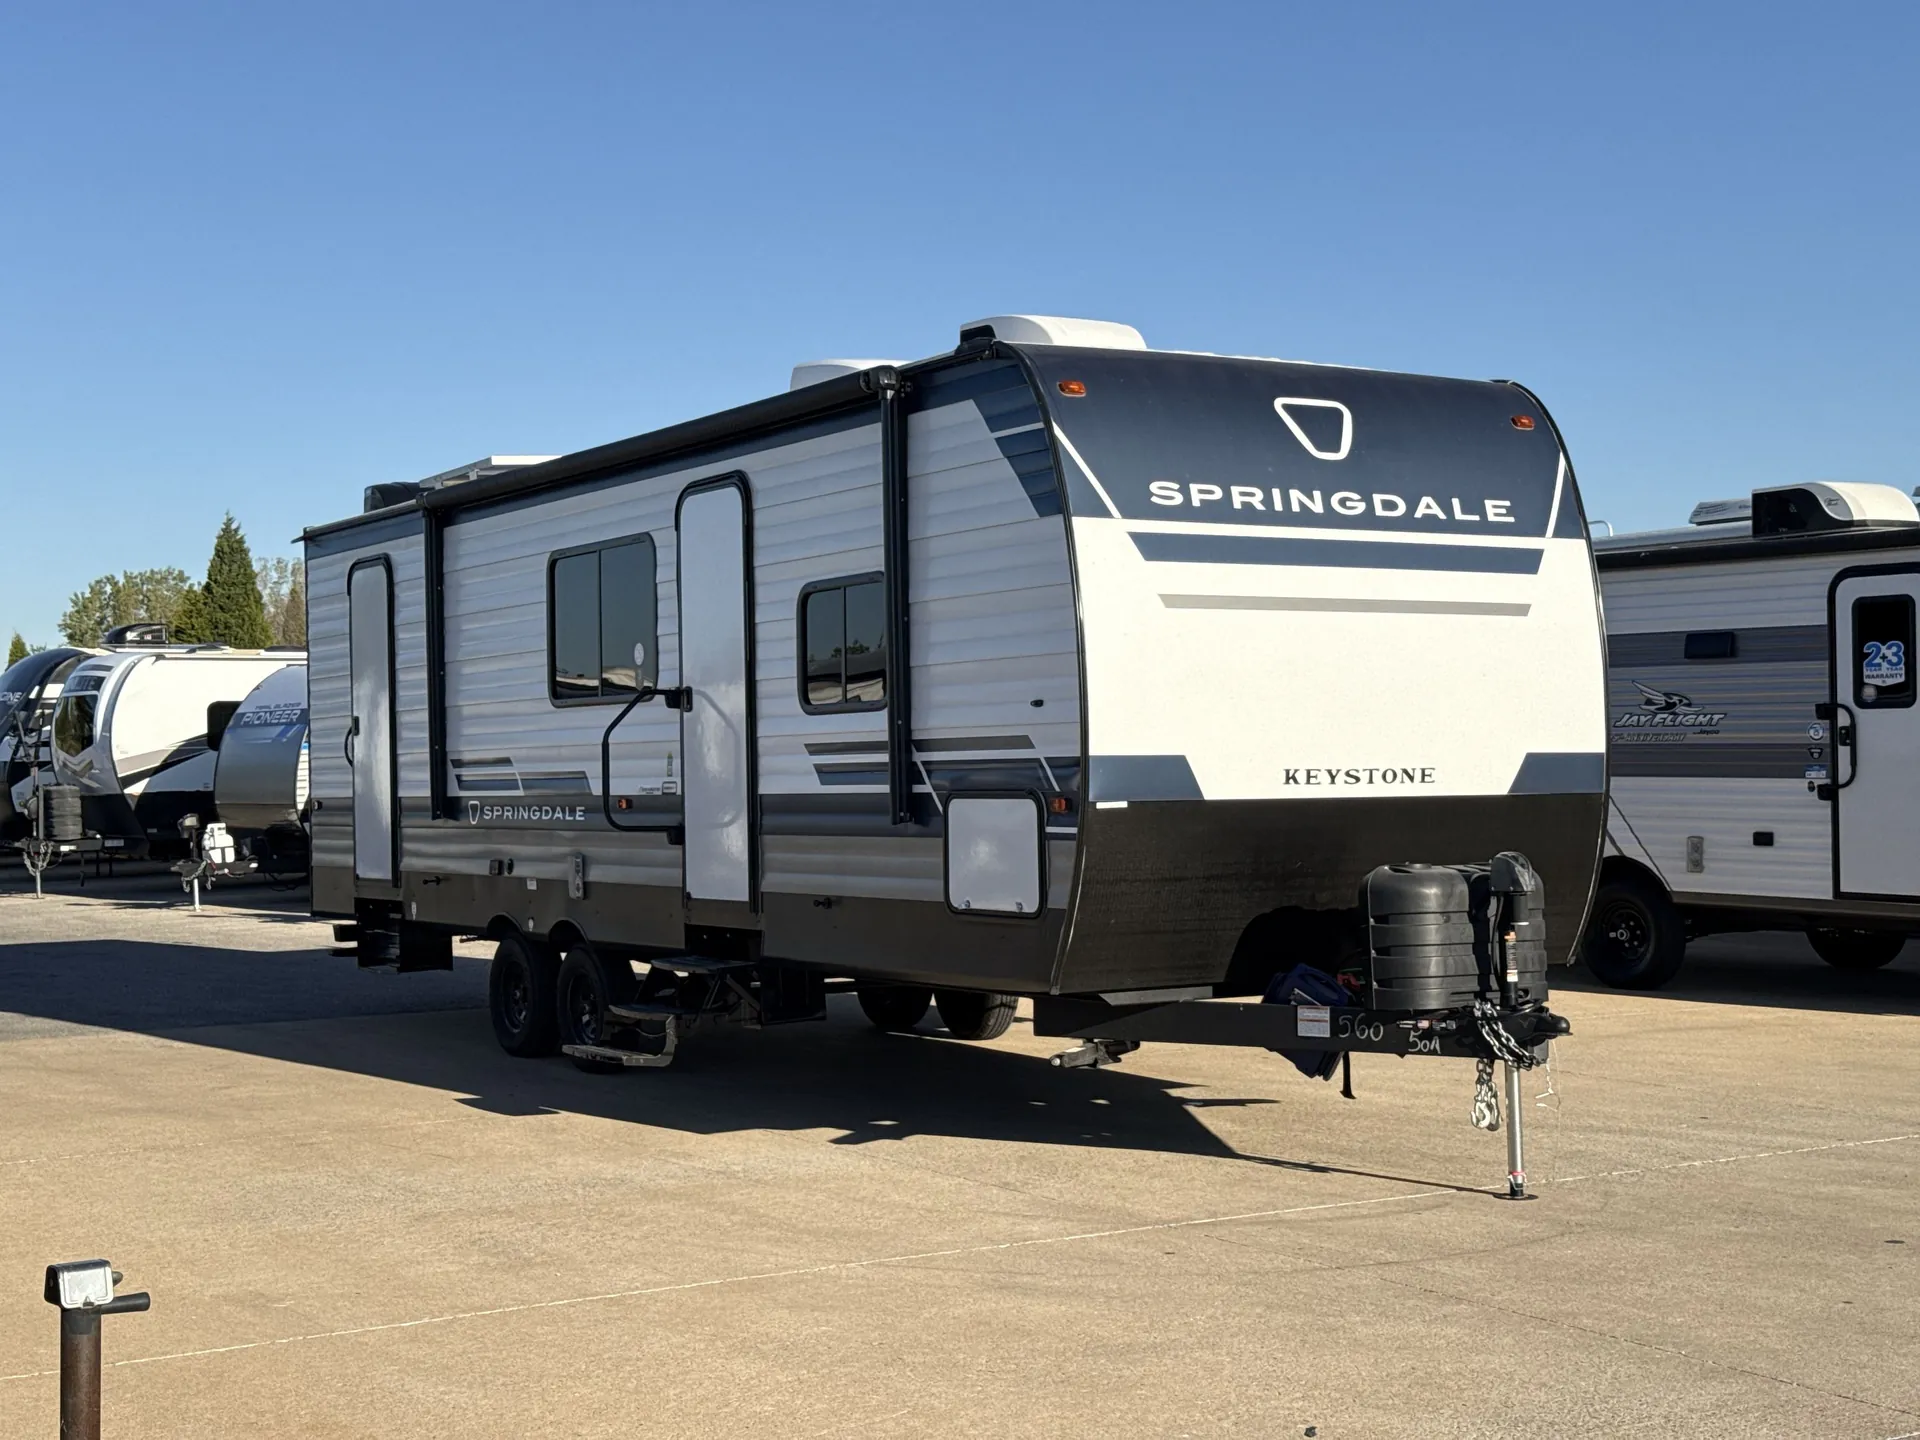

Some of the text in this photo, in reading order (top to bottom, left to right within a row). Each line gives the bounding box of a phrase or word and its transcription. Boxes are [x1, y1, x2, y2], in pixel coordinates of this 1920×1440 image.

[1149, 481, 1515, 523] SPRINGDALE
[240, 709, 301, 726] PIONEER
[1613, 713, 1727, 727] JAY FLIGHT
[1283, 767, 1436, 785] KEYSTONE
[483, 806, 586, 821] SPRINGDALE
[1338, 1013, 1384, 1041] 560
